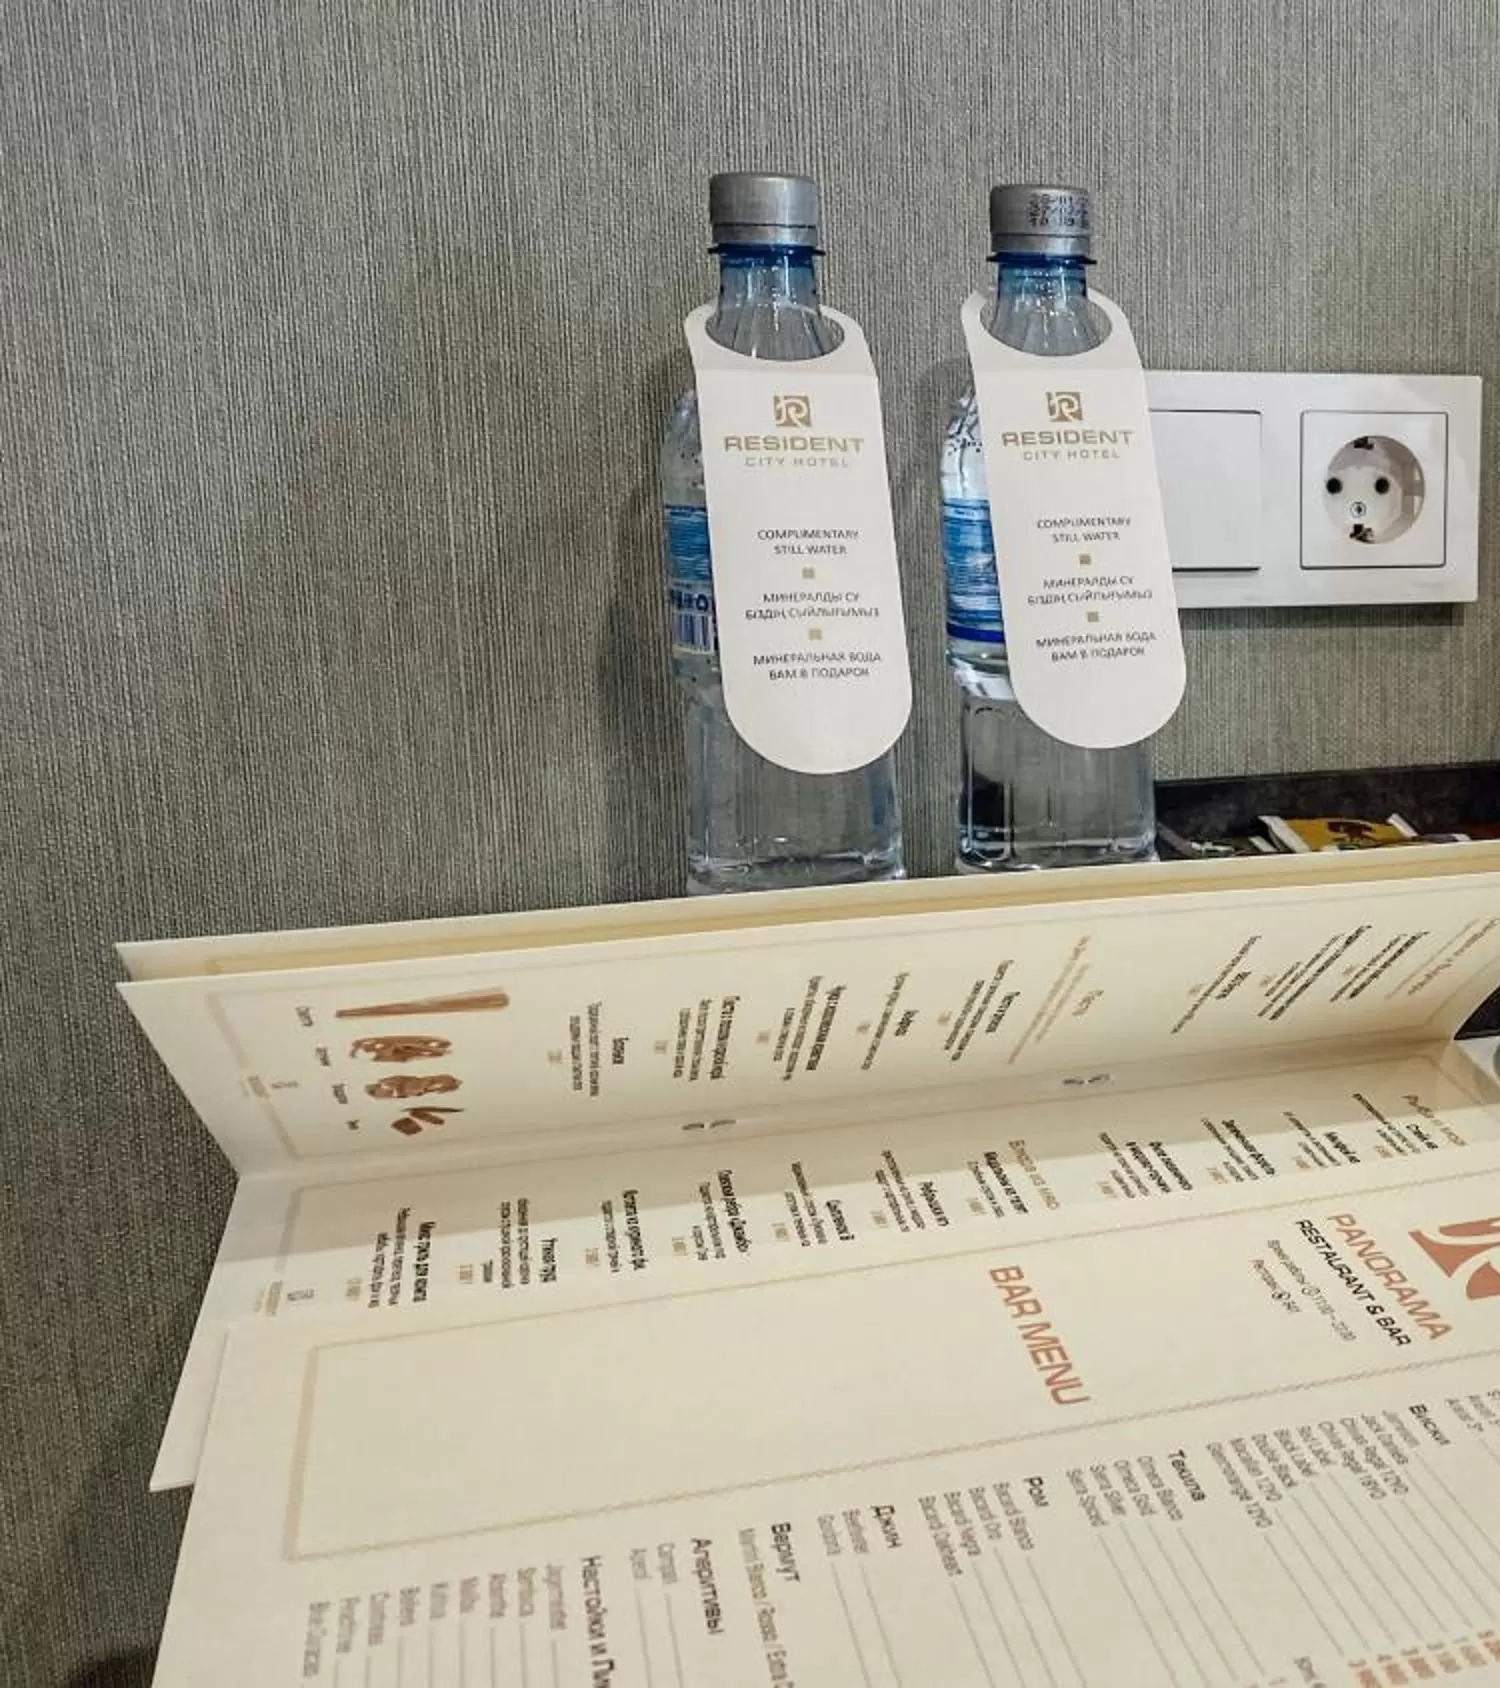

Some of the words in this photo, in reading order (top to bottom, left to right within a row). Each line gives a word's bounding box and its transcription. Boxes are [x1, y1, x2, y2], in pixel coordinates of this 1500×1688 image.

[723, 435, 865, 452] RESIDENT
[1002, 430, 1133, 447] RESIDENT
[1023, 451, 1060, 461] CITY
[1067, 449, 1120, 460] HOTEL
[744, 457, 785, 468] CITY
[793, 457, 849, 468] HOTEL
[757, 529, 859, 541] COMPLIMENTARY
[1037, 516, 1131, 529] COMPLIMENTARY
[1083, 531, 1120, 542] WATER
[774, 545, 804, 556] STILL
[808, 545, 847, 555] WATER
[1290, 1219, 1379, 1303] RESTAURANT
[1322, 1212, 1463, 1340] PANORAMA
[983, 1264, 1050, 1319] BAR
[1362, 1303, 1389, 1315] &
[1372, 1315, 1416, 1347] BAR
[1012, 1319, 1099, 1408] MENU
[1404, 1402, 1458, 1447] Виски
[1021, 1474, 1056, 1508] Ром
[1162, 1448, 1214, 1504] Текила
[867, 1501, 909, 1551] Джин
[763, 1521, 806, 1586] Вермут
[578, 1554, 612, 1641] Настойки
[686, 1534, 731, 1638] Аперитивы
[587, 1641, 609, 1657] и
